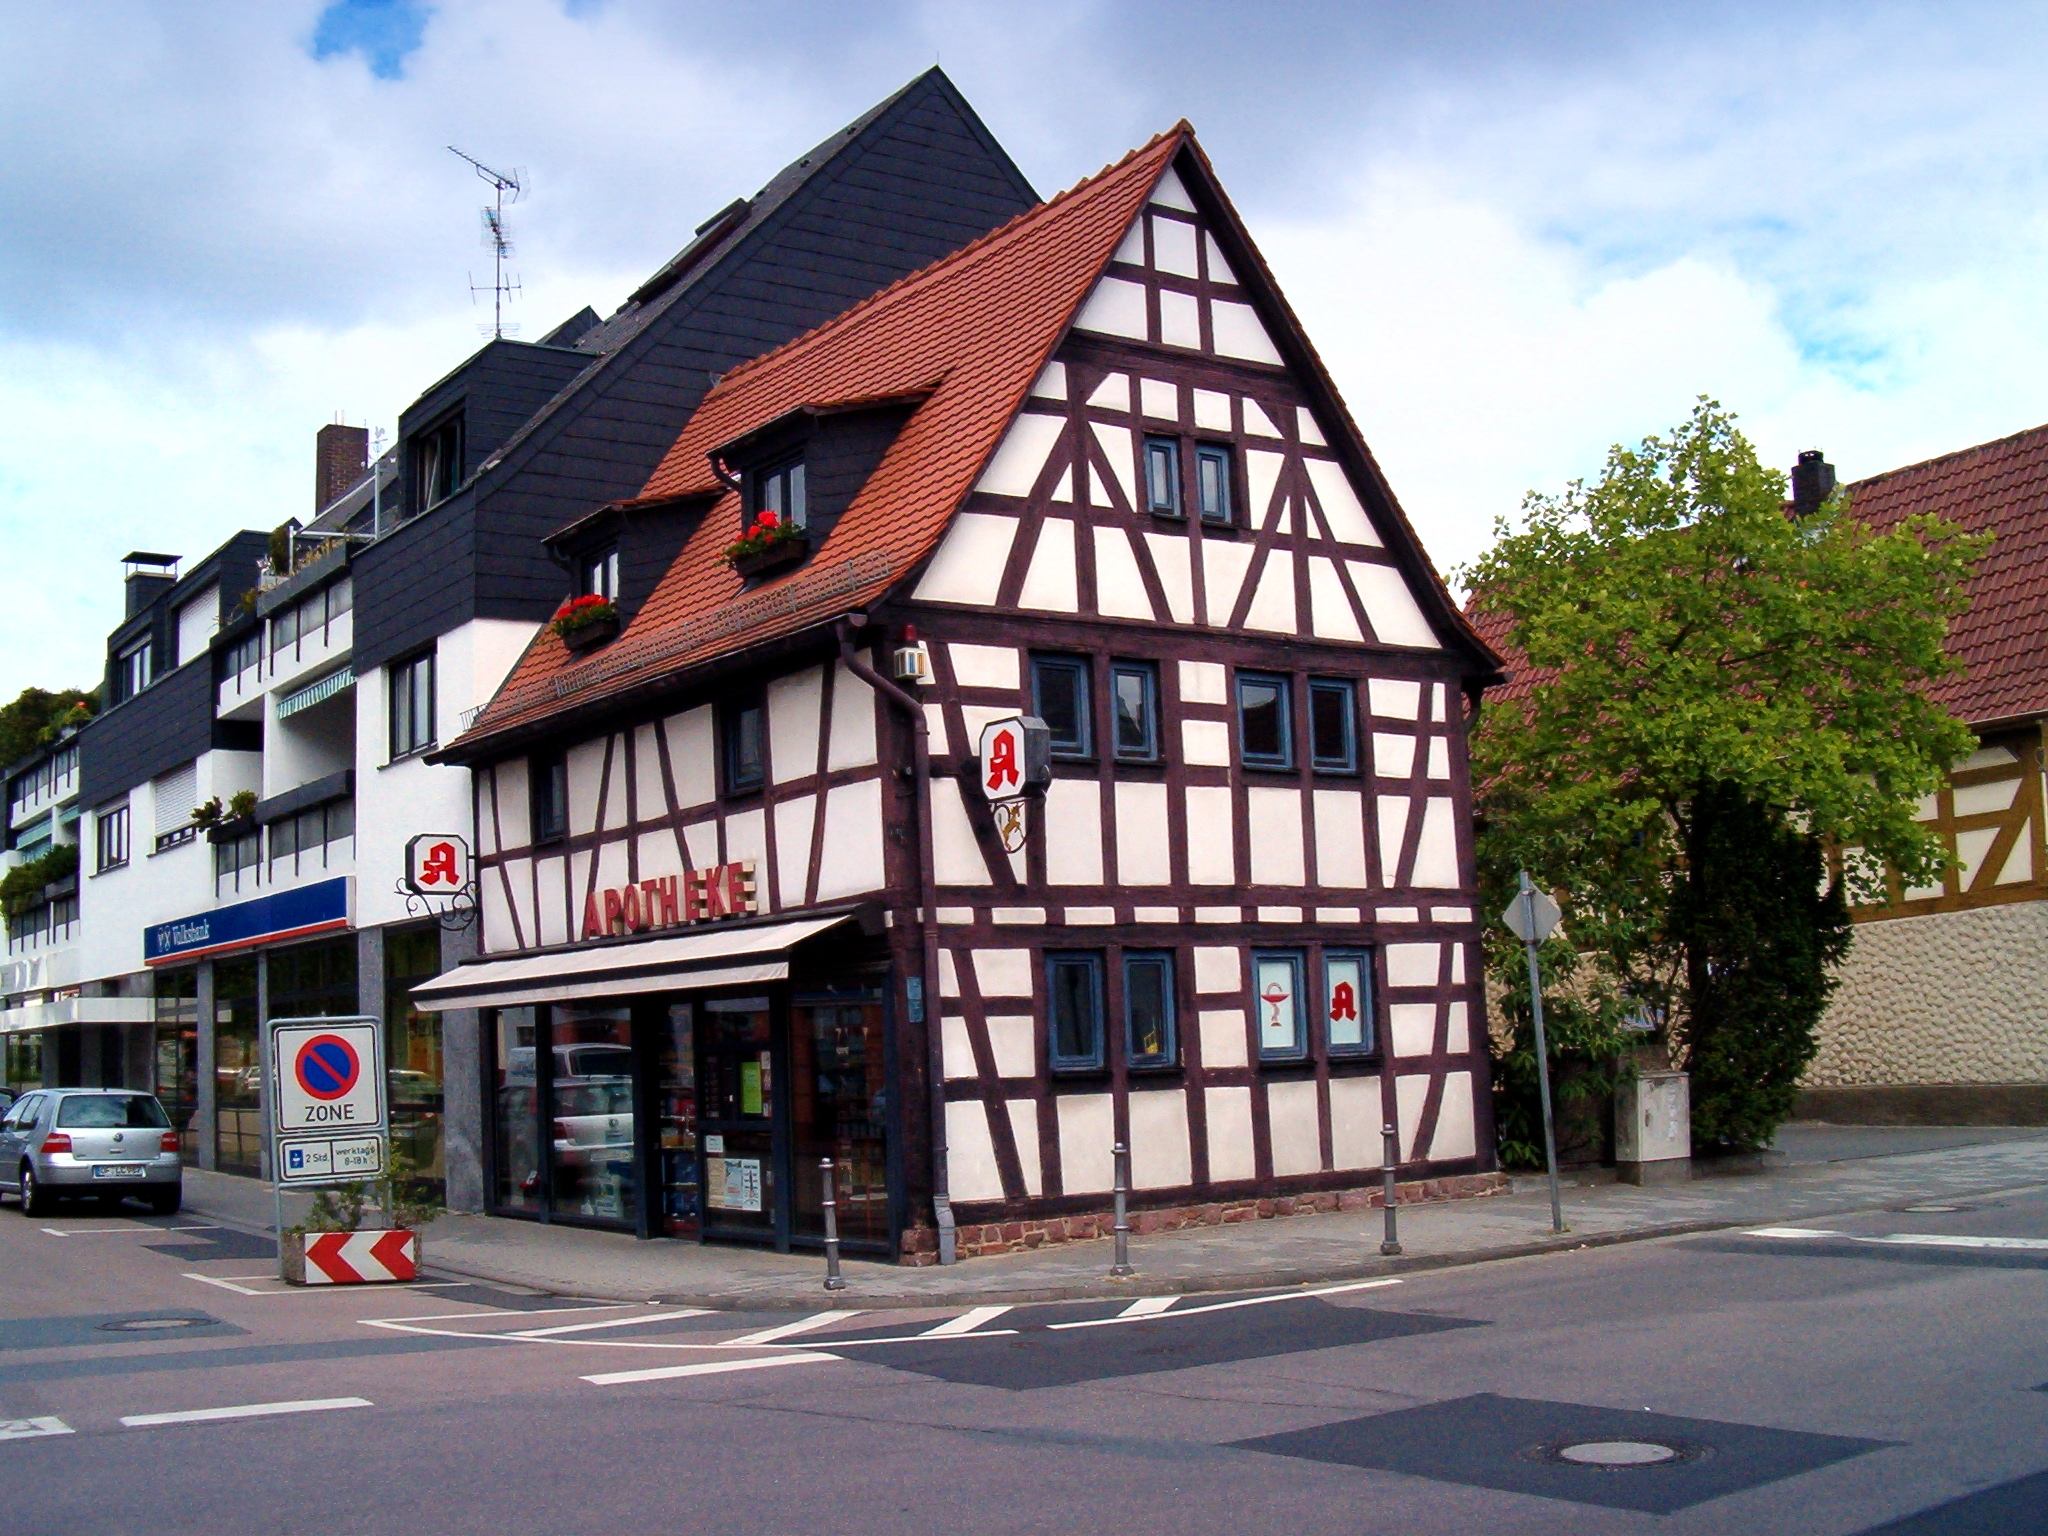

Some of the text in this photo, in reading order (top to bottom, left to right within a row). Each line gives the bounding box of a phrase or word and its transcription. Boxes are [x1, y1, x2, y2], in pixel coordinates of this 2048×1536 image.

[987, 729, 1019, 791] A
[419, 842, 460, 885] A
[583, 861, 754, 937] APOTHEKE
[305, 1103, 355, 1122] ZONE
[306, 1154, 311, 1163] 2
